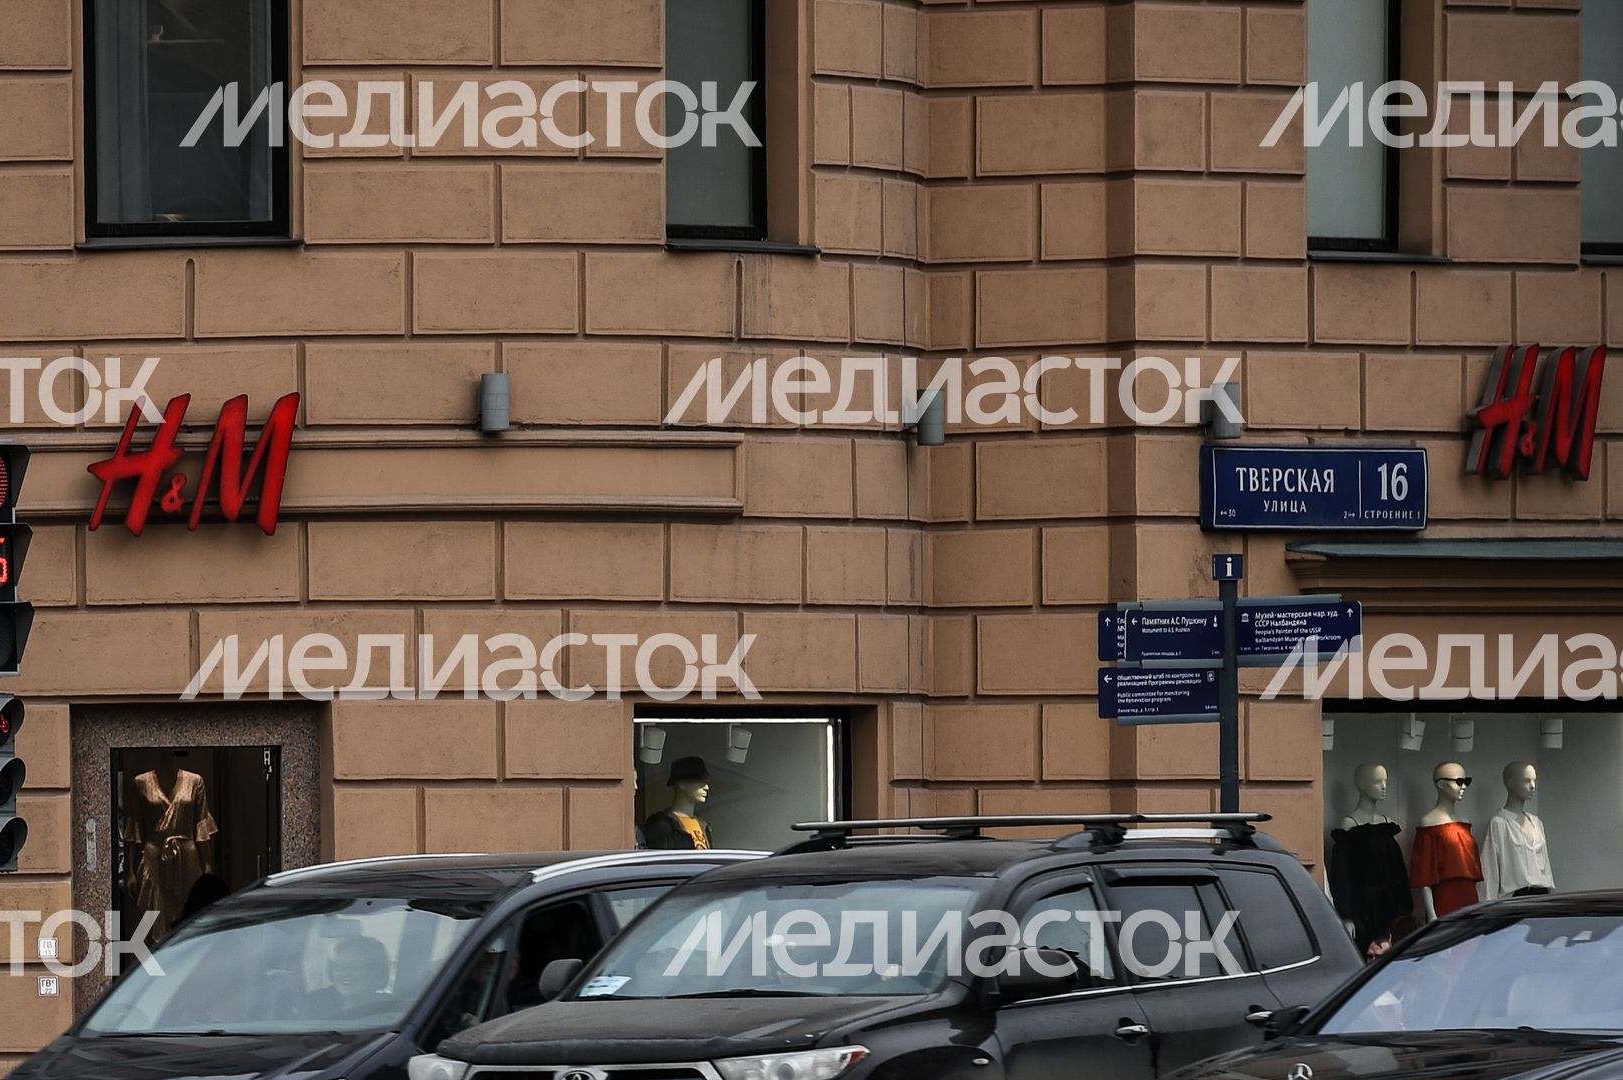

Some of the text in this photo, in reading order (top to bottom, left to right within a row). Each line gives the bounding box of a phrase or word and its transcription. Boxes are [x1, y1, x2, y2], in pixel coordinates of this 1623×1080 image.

[1467, 343, 1607, 481] H&M
[87, 391, 299, 537] H&M
[1236, 462, 1409, 501] ТВЕРСКАЯ 16
[1263, 500, 1307, 513] УЛИЦА
[1364, 510, 1413, 519] СТРОЕНИЕ
